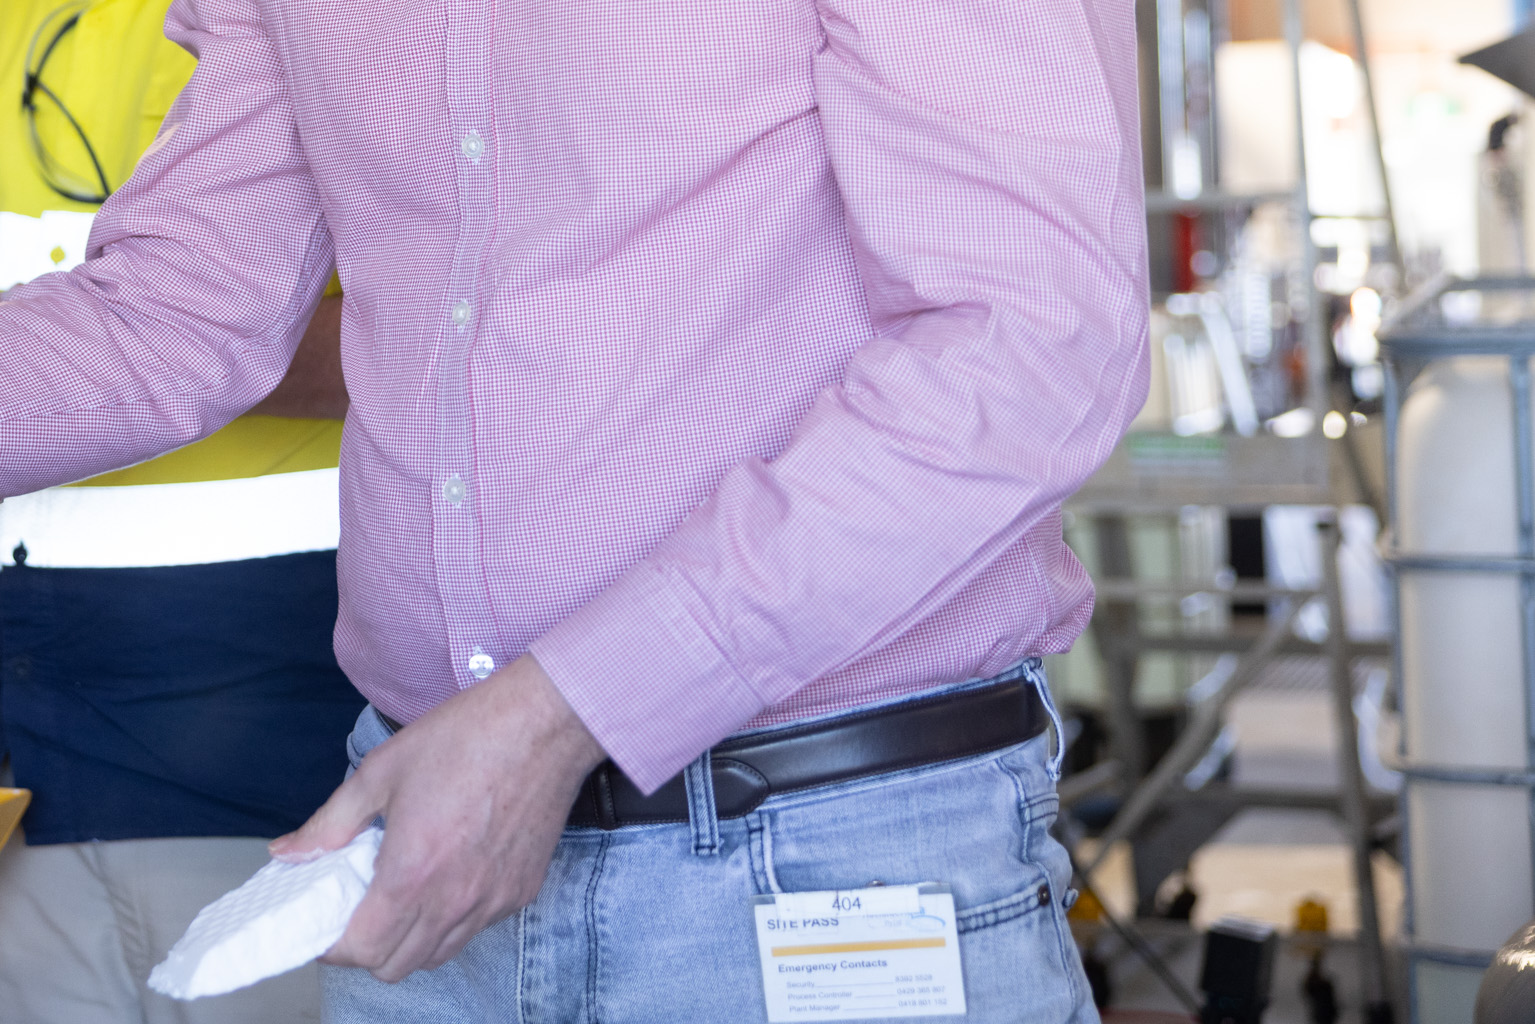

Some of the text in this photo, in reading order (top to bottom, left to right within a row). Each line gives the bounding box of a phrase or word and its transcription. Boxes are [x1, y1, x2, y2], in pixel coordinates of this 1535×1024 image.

[832, 897, 862, 911] 404
[767, 917, 839, 931] SITE PASS
[778, 959, 888, 974] Emergency Contacts
[786, 980, 815, 989] Security
[787, 992, 816, 1001] Process
[818, 990, 852, 999] Controller
[789, 1004, 807, 1013] Plant
[809, 1003, 840, 1013] Manager
